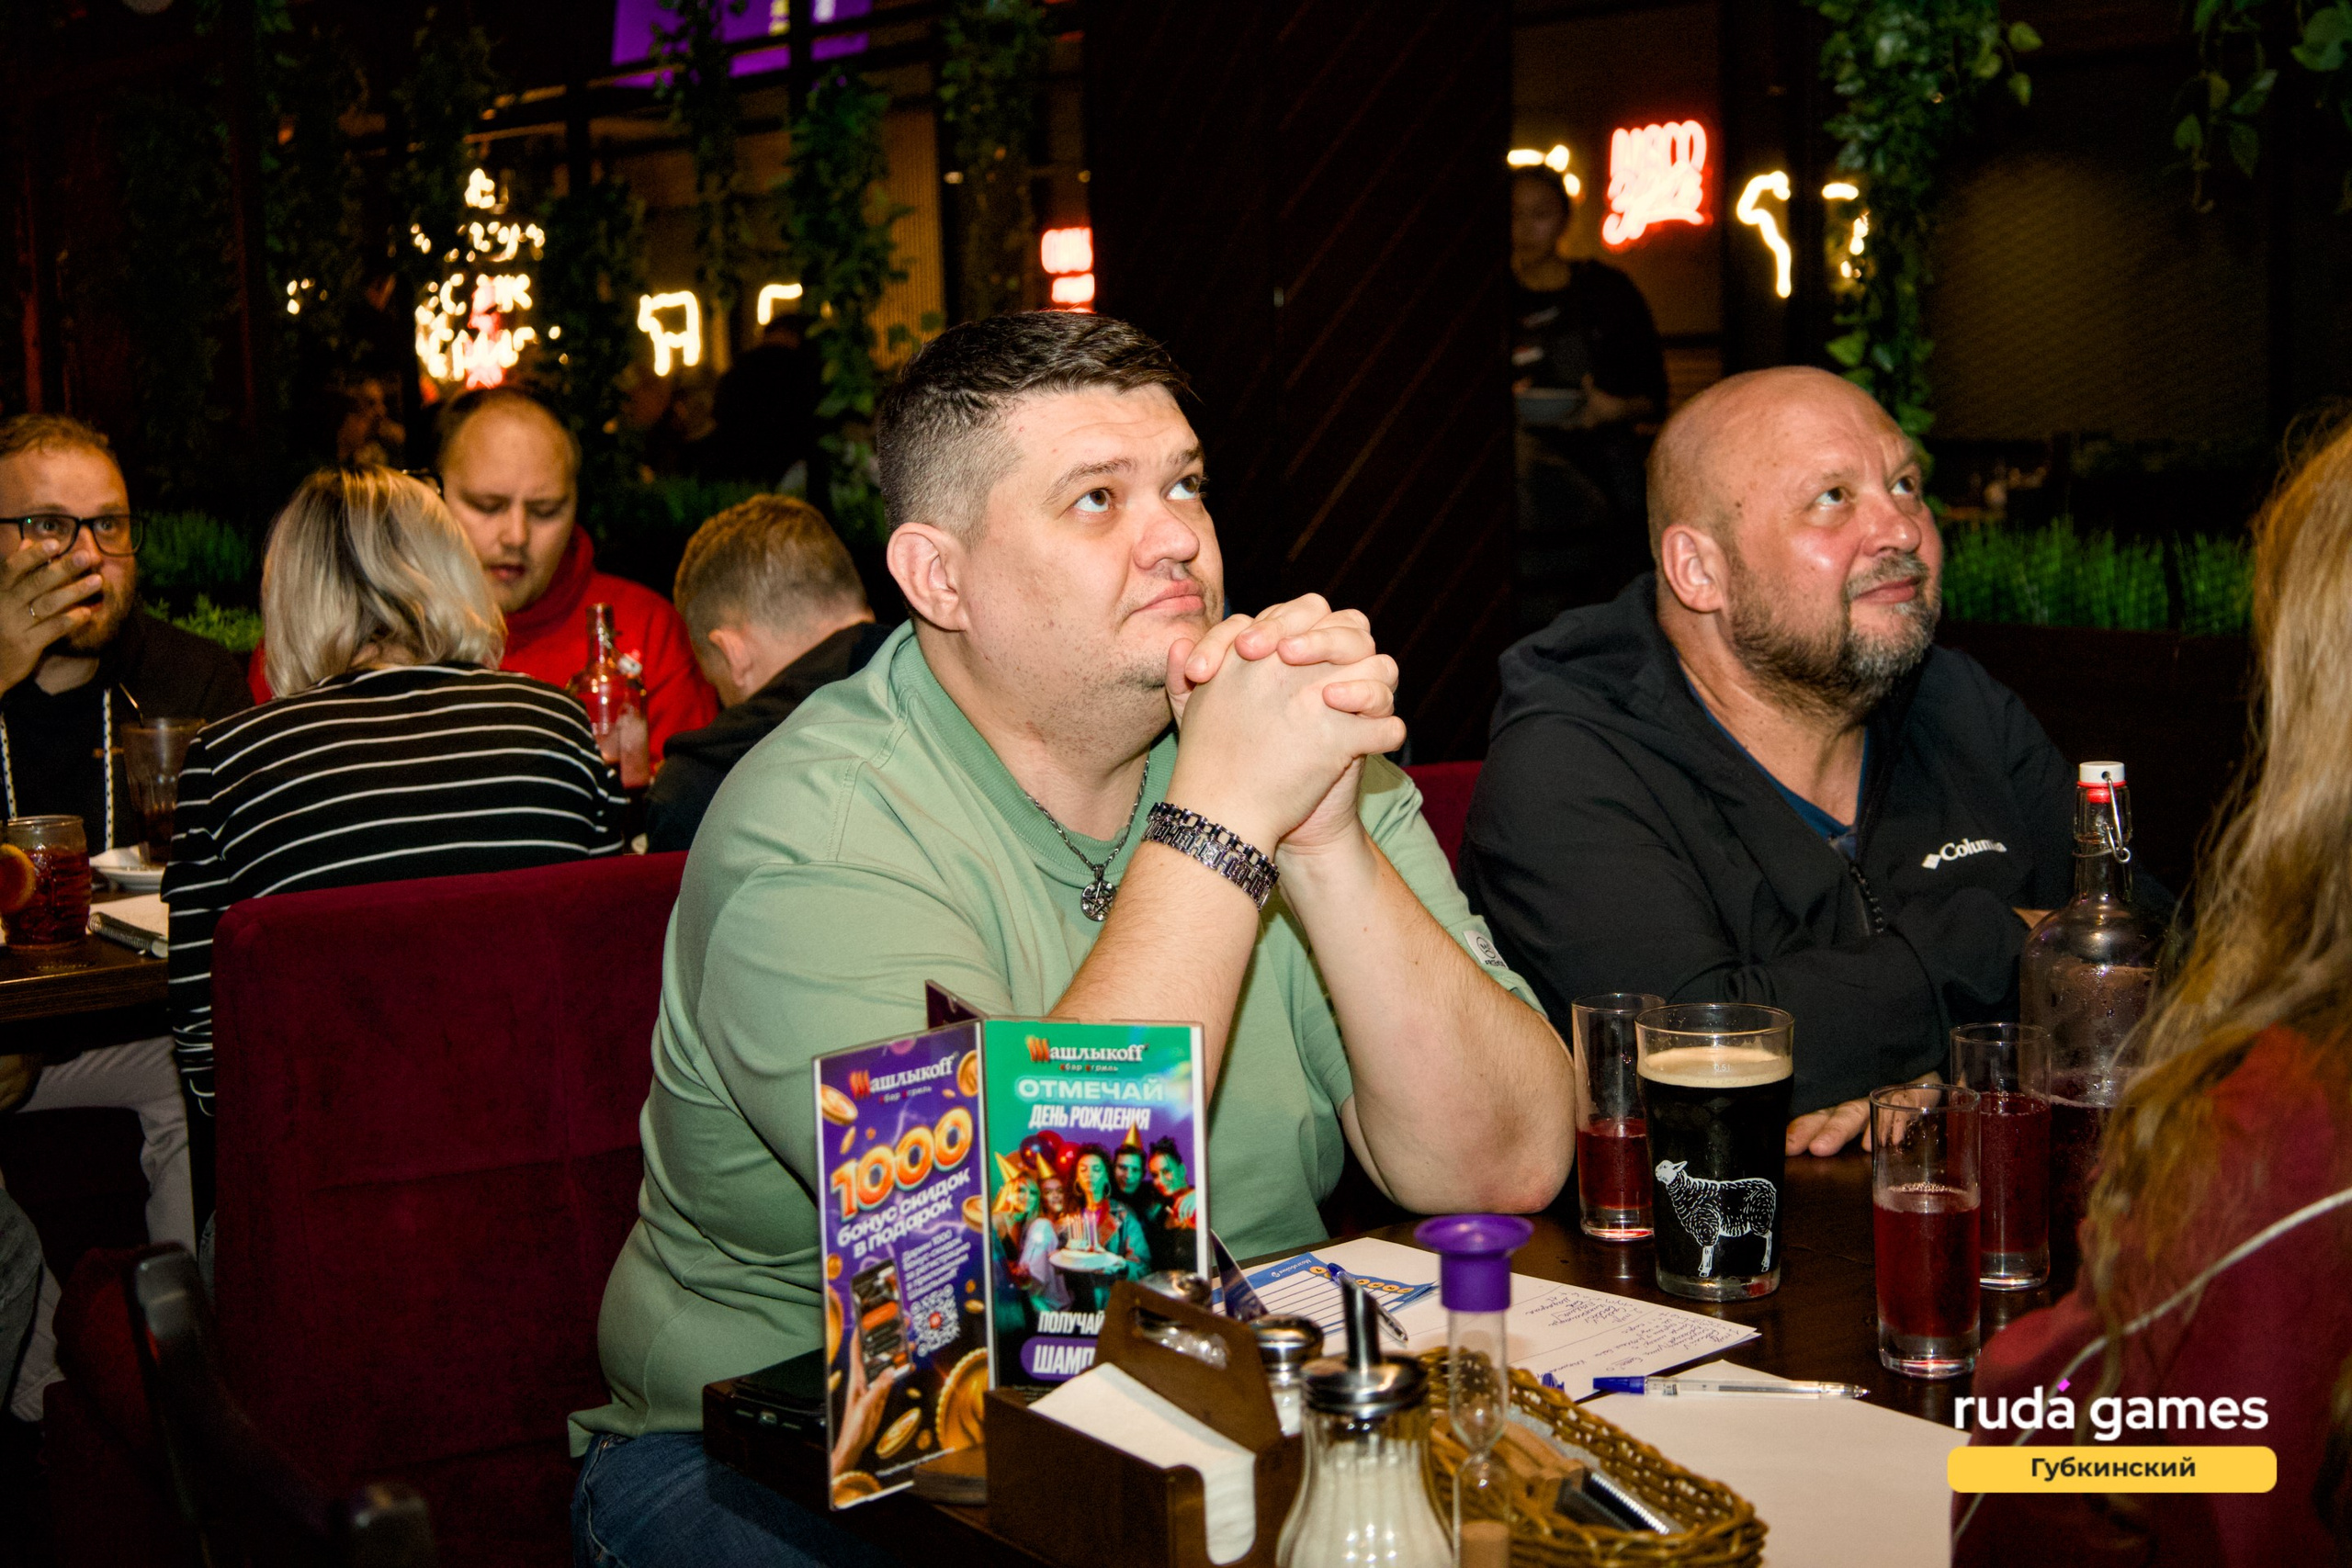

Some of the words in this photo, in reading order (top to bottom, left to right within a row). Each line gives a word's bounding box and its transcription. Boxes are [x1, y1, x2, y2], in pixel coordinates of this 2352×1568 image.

[1017, 1078, 1164, 1101] ОТМЕЧАЙ
[1028, 1104, 1069, 1129] ДЕНЬ
[1069, 1105, 1151, 1131] РОЖДЕНИЯ
[831, 1106, 974, 1223] 1000
[837, 1205, 898, 1247] бонус
[899, 1168, 971, 1214] скидок
[854, 1240, 867, 1259] в
[868, 1195, 954, 1251] подарок
[1037, 1310, 1106, 1335] ПОЛУЧАЙ
